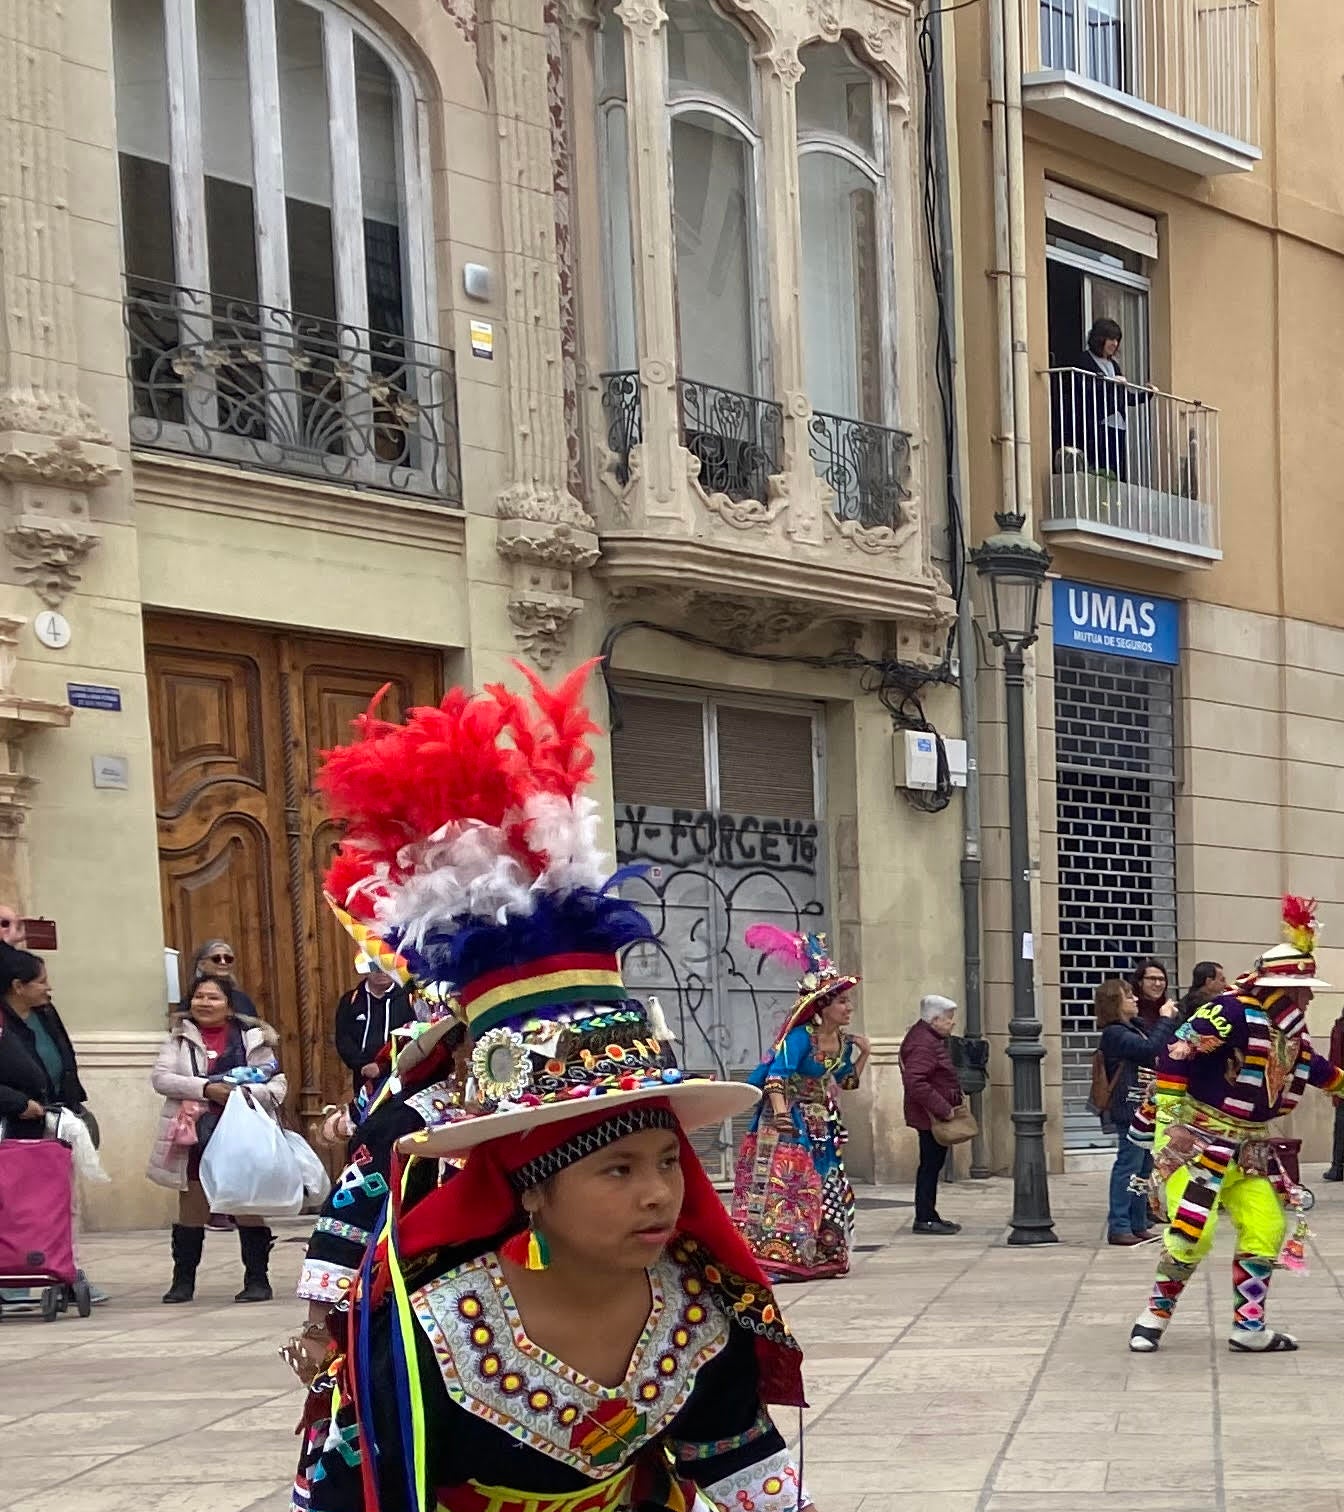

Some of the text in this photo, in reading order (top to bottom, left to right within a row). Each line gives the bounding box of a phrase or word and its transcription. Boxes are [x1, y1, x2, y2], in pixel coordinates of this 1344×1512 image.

[1068, 588, 1156, 637] UMAS
[46, 616, 62, 642] 4
[1073, 629, 1153, 653] MUTUA DE SEGUROS
